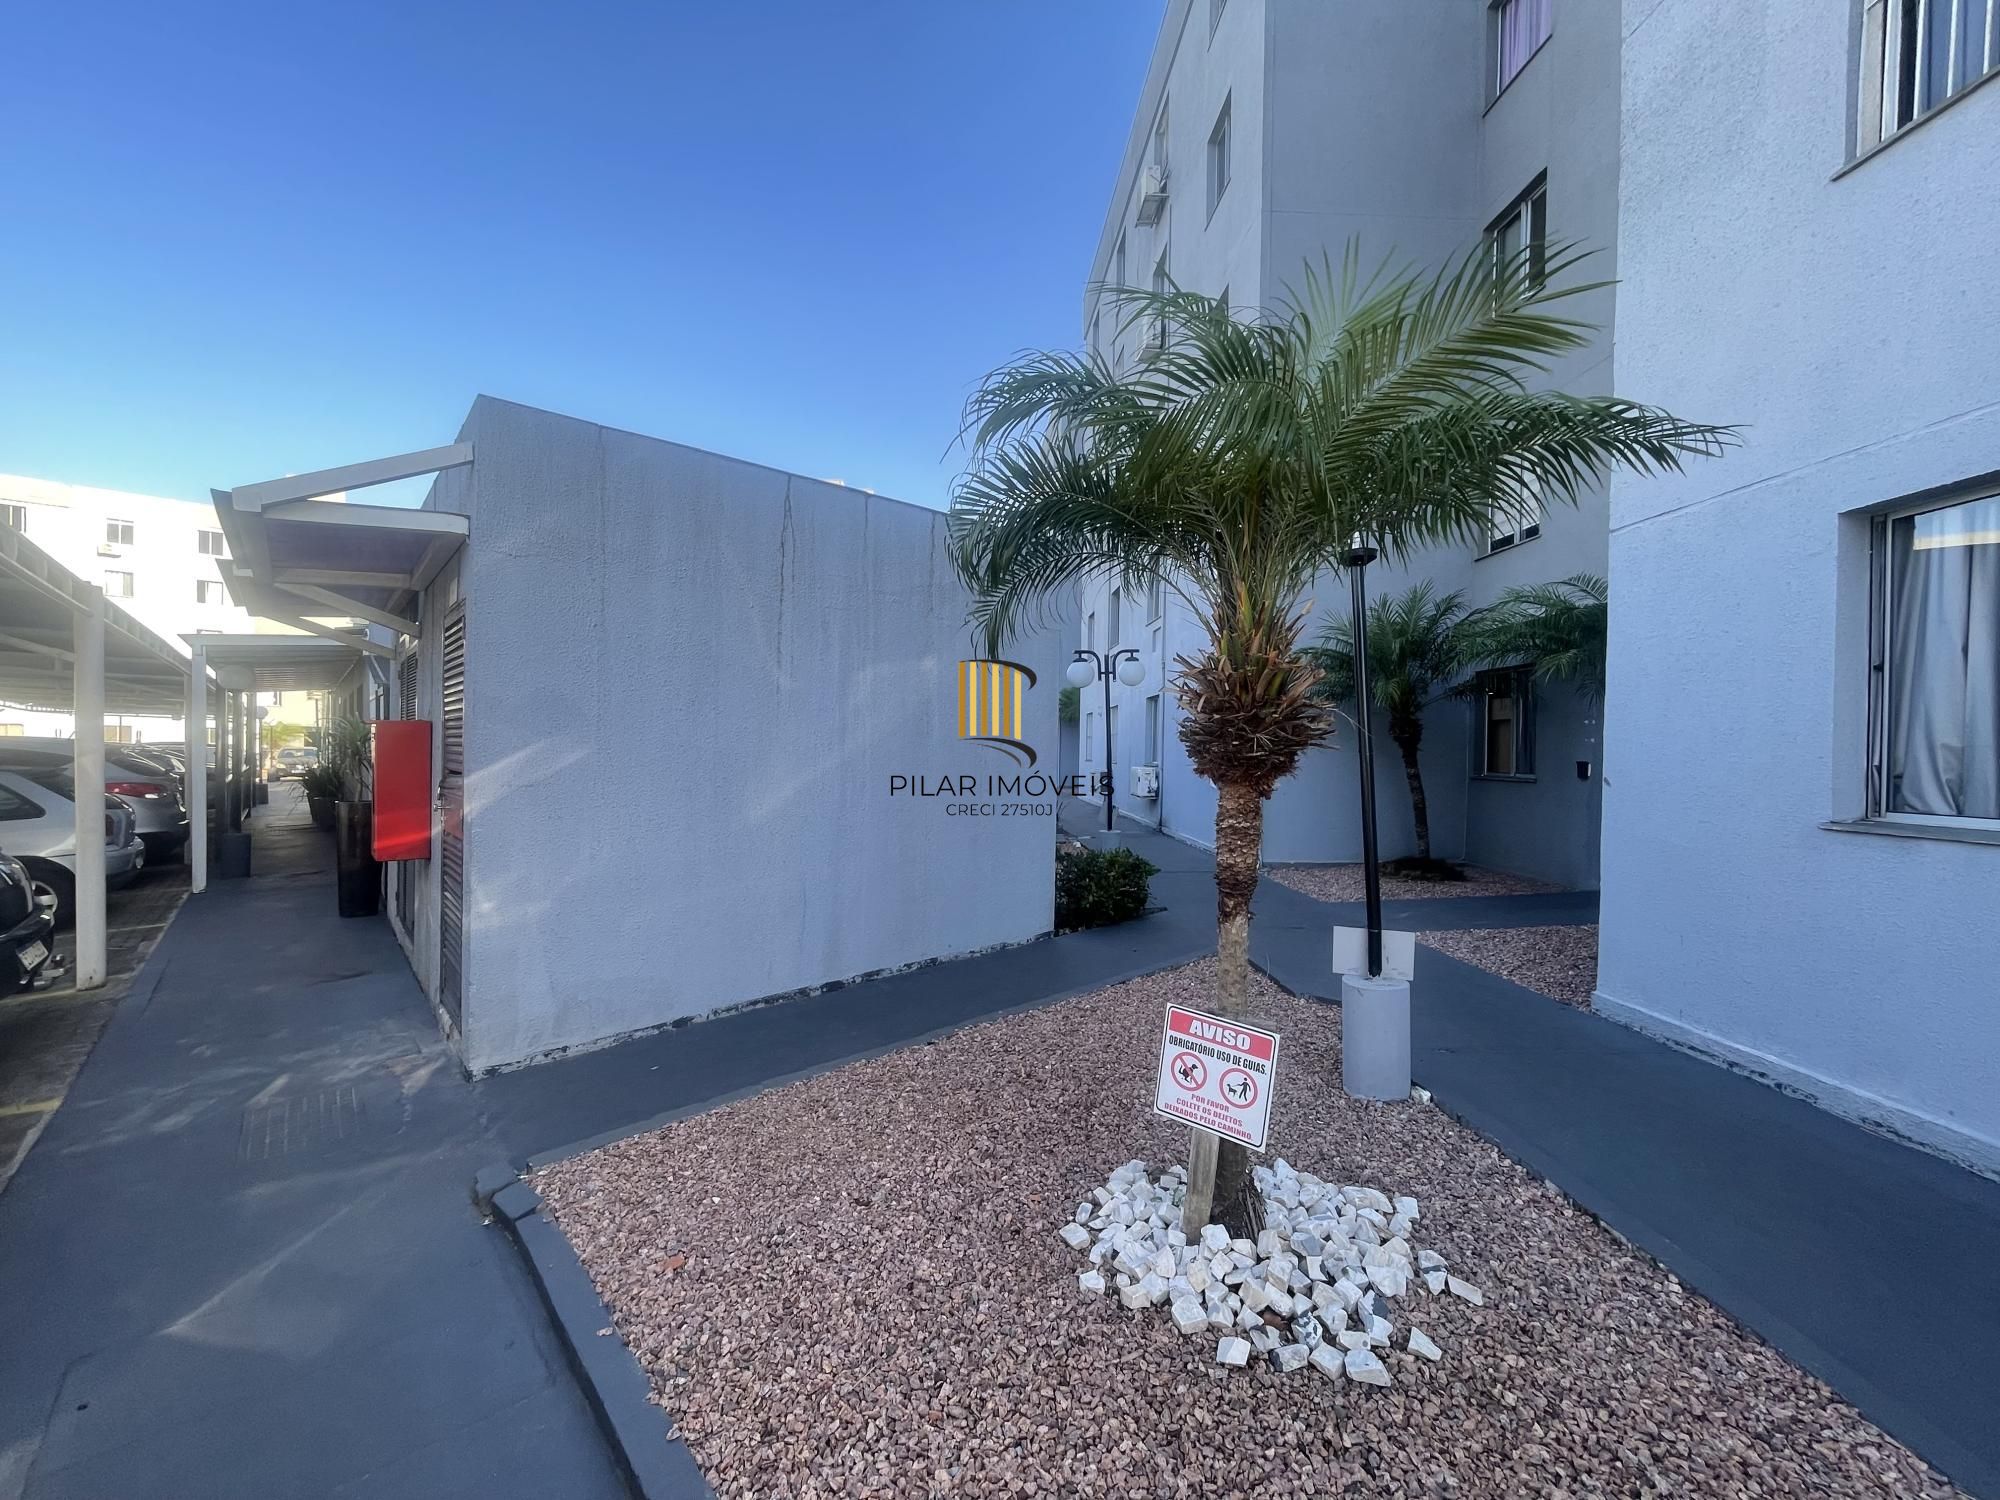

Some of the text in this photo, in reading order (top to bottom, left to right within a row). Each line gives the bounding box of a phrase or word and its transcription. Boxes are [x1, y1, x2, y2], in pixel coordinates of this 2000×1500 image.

[1189, 1019, 1251, 1051] AVISO
[1168, 1034, 1267, 1076] OBRIGATÓRIO USO DE GUIAS.
[1164, 1102, 1198, 1120] DEIXADOS
[1199, 1115, 1216, 1127] PELO
[1176, 1097, 1243, 1127] COLETE OS DEJETOS
[1191, 1093, 1230, 1113] POR FAVOR
